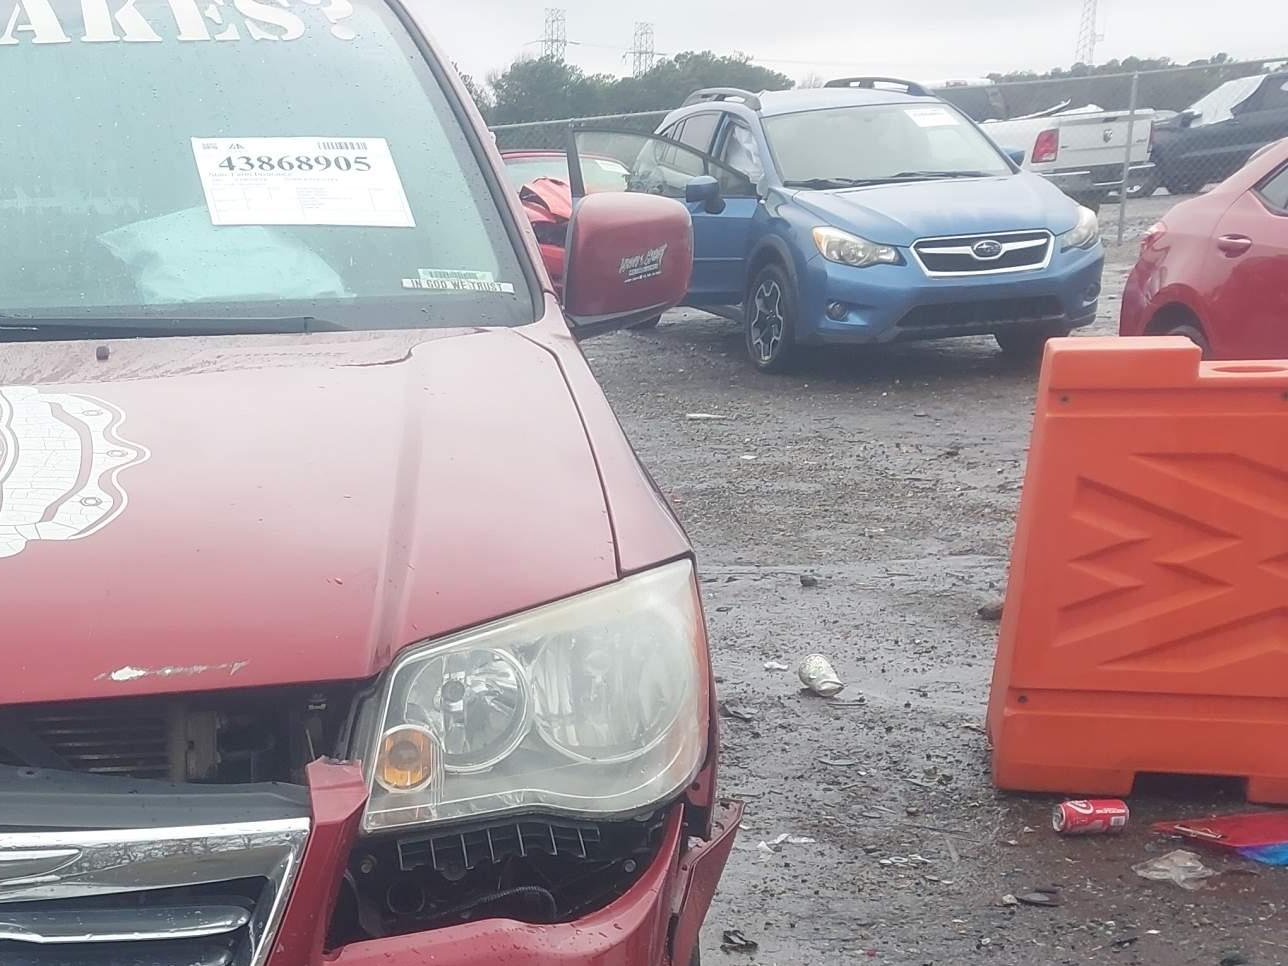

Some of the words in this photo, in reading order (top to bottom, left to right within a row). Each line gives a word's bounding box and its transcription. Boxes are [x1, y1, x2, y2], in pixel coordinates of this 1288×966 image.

[217, 154, 372, 172] 43868905
[411, 279, 422, 288] IN
[426, 279, 449, 289] GOD
[452, 279, 465, 290] WE
[469, 280, 503, 292] TRUST
